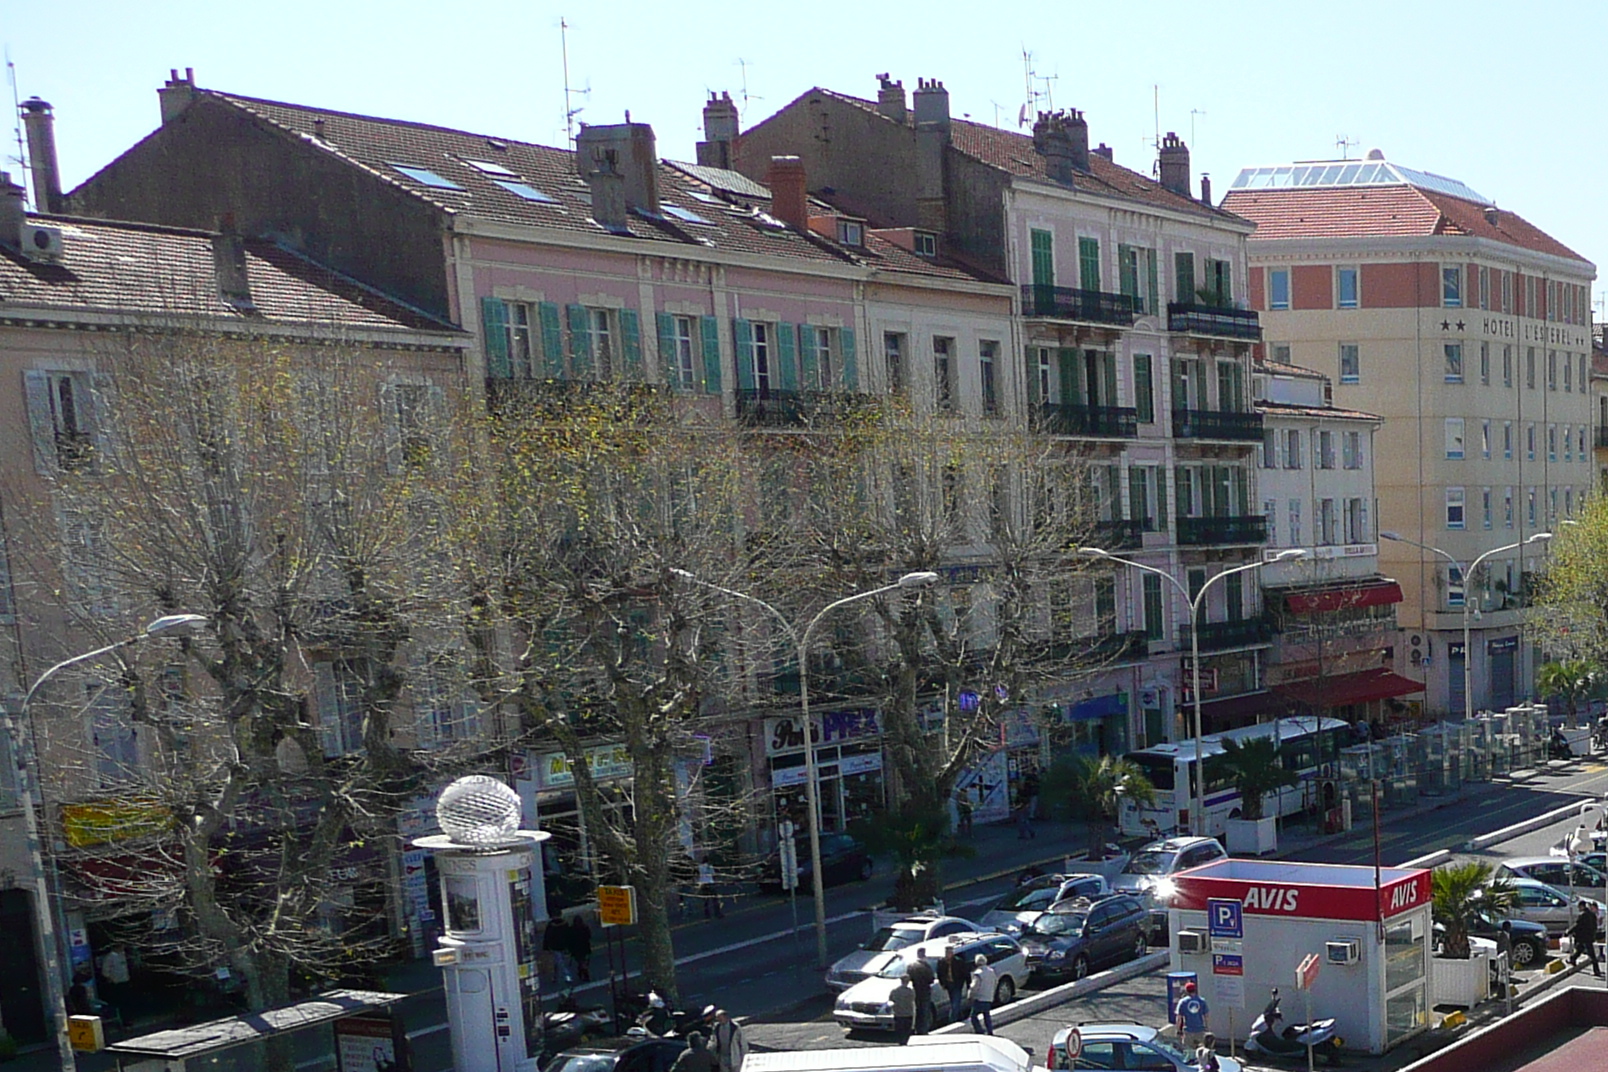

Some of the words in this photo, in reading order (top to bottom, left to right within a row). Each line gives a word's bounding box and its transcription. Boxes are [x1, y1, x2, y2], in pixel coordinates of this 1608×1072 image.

[1483, 318, 1514, 338] HOTEL
[1243, 887, 1299, 911] AVIS
[1390, 880, 1417, 909] AVIS
[1219, 906, 1231, 924] P
